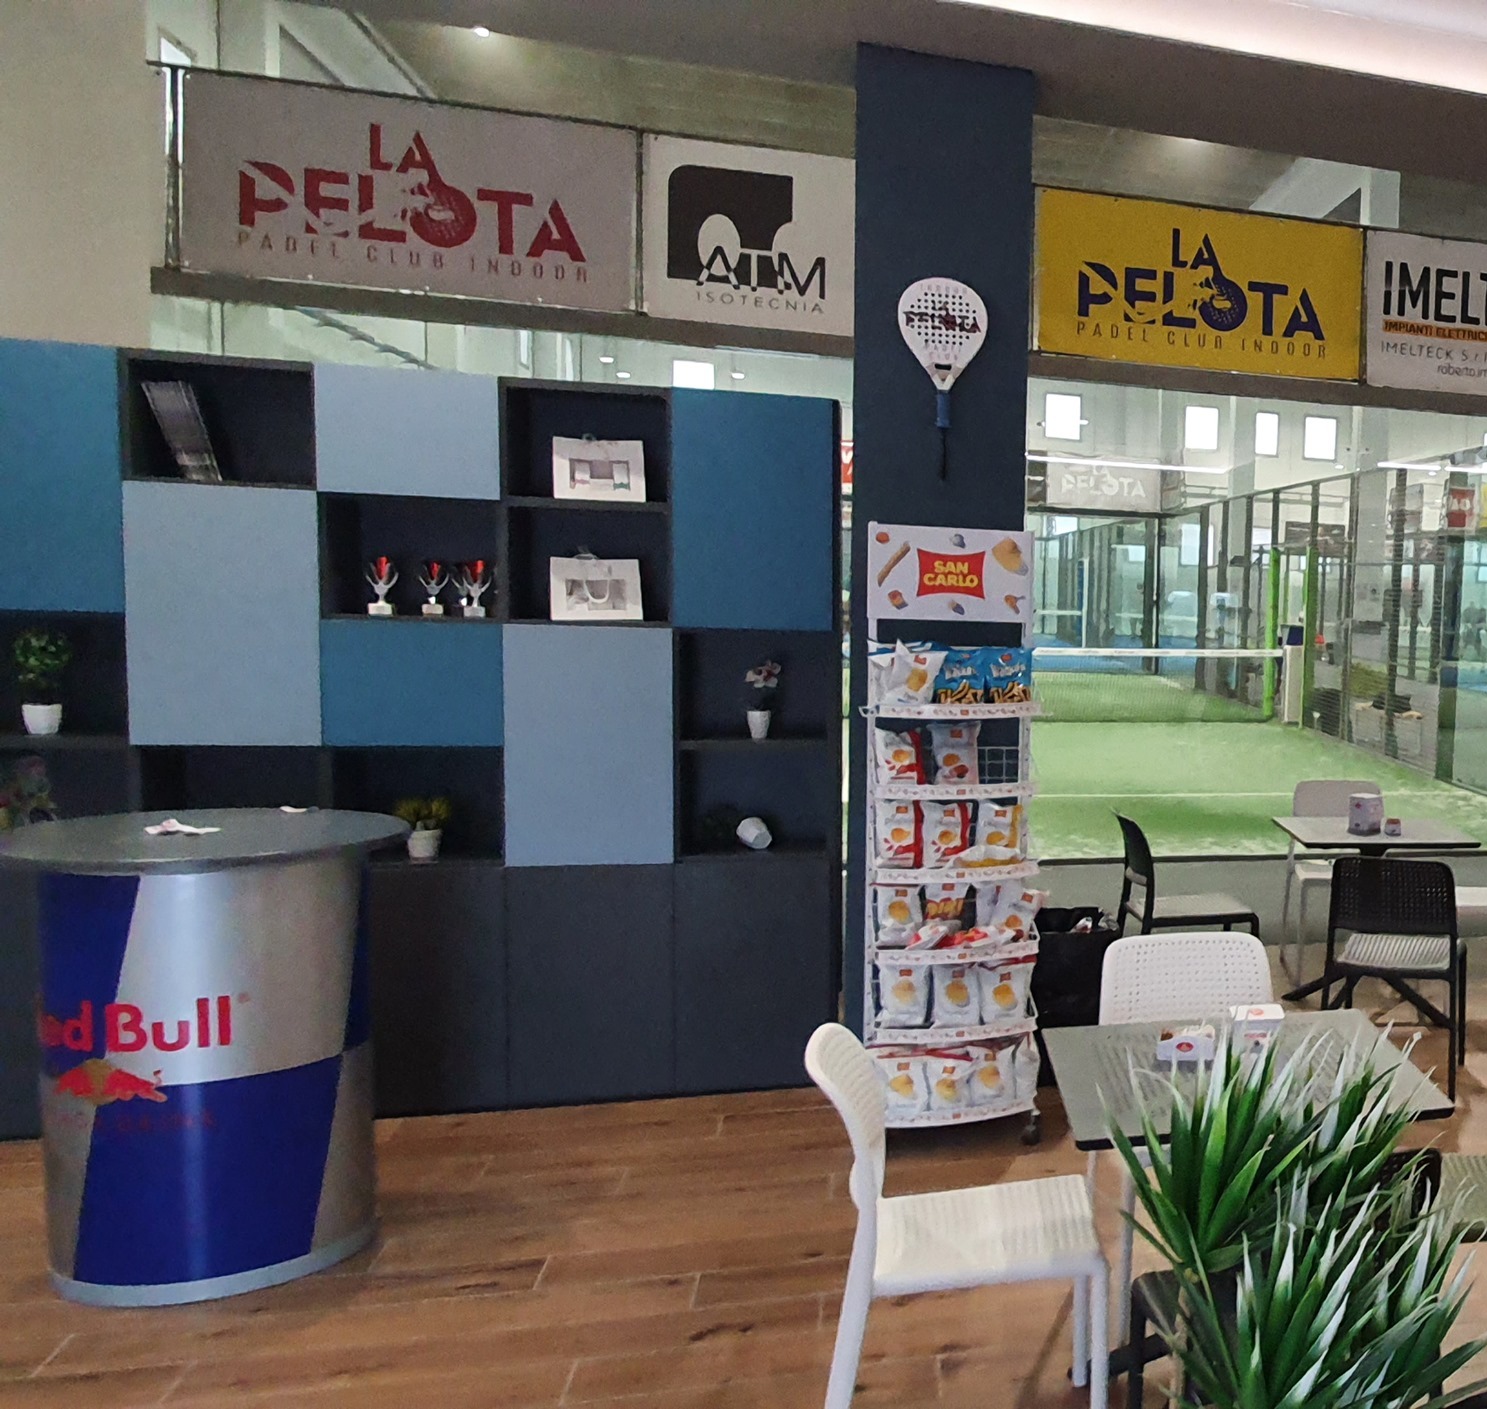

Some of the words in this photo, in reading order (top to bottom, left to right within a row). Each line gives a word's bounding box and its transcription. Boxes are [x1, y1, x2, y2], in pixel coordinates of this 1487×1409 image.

[368, 122, 440, 175] LA
[239, 160, 586, 263] PELOTA
[236, 231, 341, 262] PADEL
[366, 245, 444, 270] CLUB
[469, 256, 590, 284] INDOOR
[1172, 227, 1222, 270] LA
[696, 245, 826, 300] ATM
[696, 291, 825, 314] ISOTECNIA
[1077, 260, 1326, 341] PELOTA
[1076, 320, 1149, 342] PADEL
[1167, 330, 1224, 350] CLUB
[1241, 337, 1326, 359] INDOOR
[1381, 340, 1454, 361] IMELTECK
[1384, 320, 1433, 336] IMPIANTI
[1436, 326, 1487, 342] ELETTRICI
[923, 572, 980, 589] CARLO
[933, 560, 969, 574] SAN
[104, 995, 232, 1053] Bull
